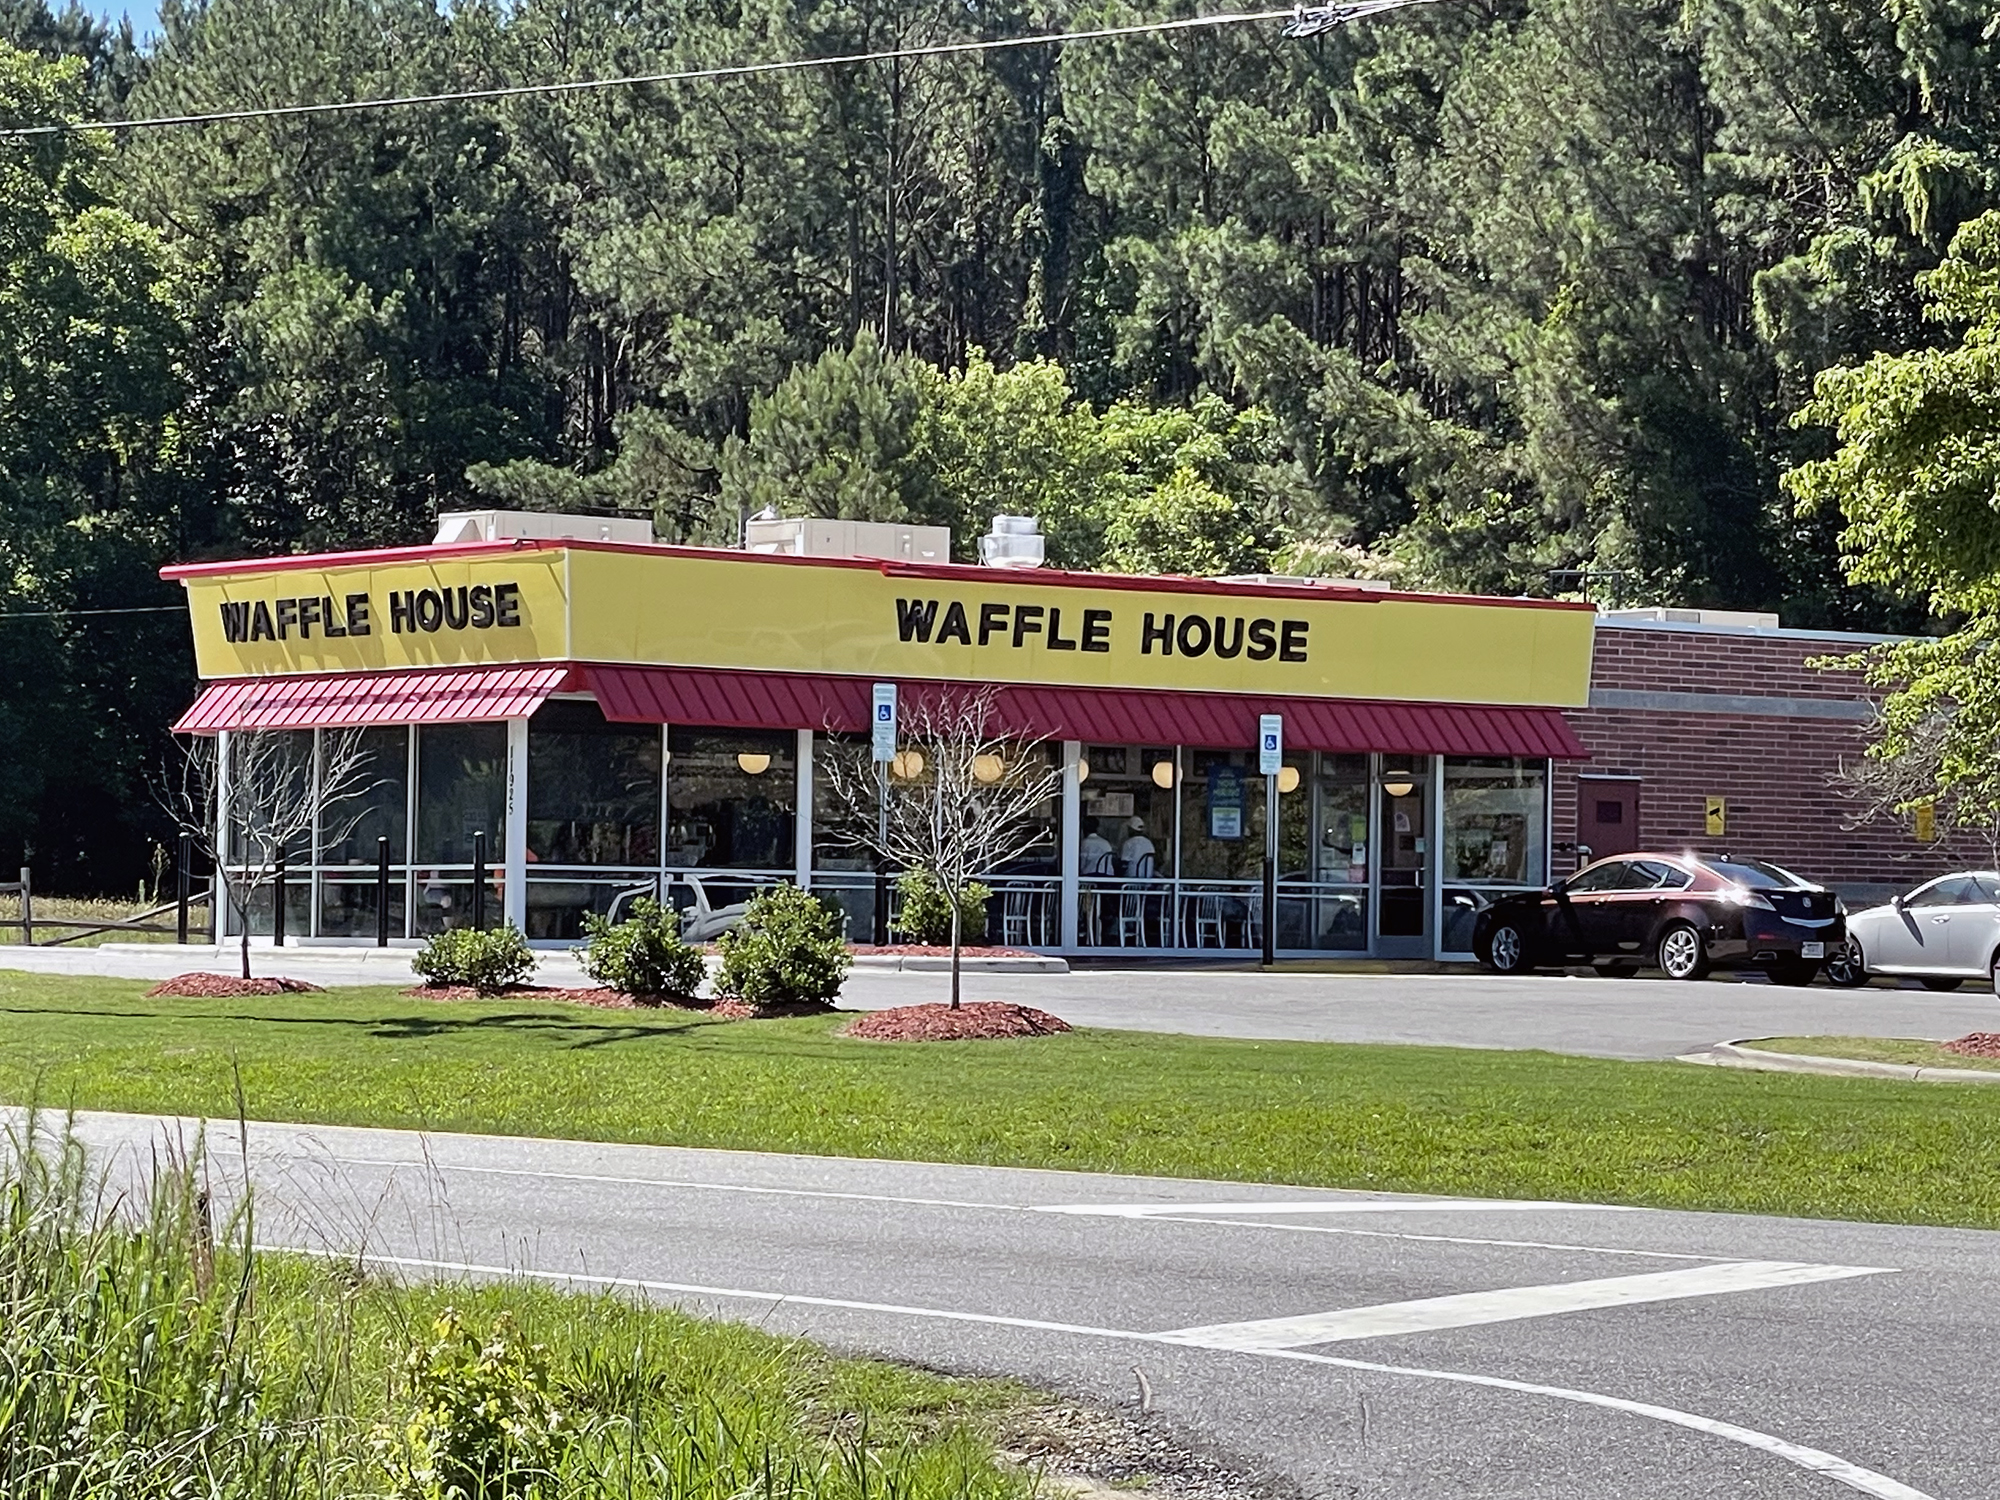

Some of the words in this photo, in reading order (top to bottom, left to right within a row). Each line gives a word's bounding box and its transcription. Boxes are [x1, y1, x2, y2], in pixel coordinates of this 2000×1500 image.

[219, 592, 371, 643] WAFFLE
[388, 583, 521, 633] HOUSE
[895, 598, 1113, 652] WAFFLE
[1141, 612, 1309, 662] HOUSE
